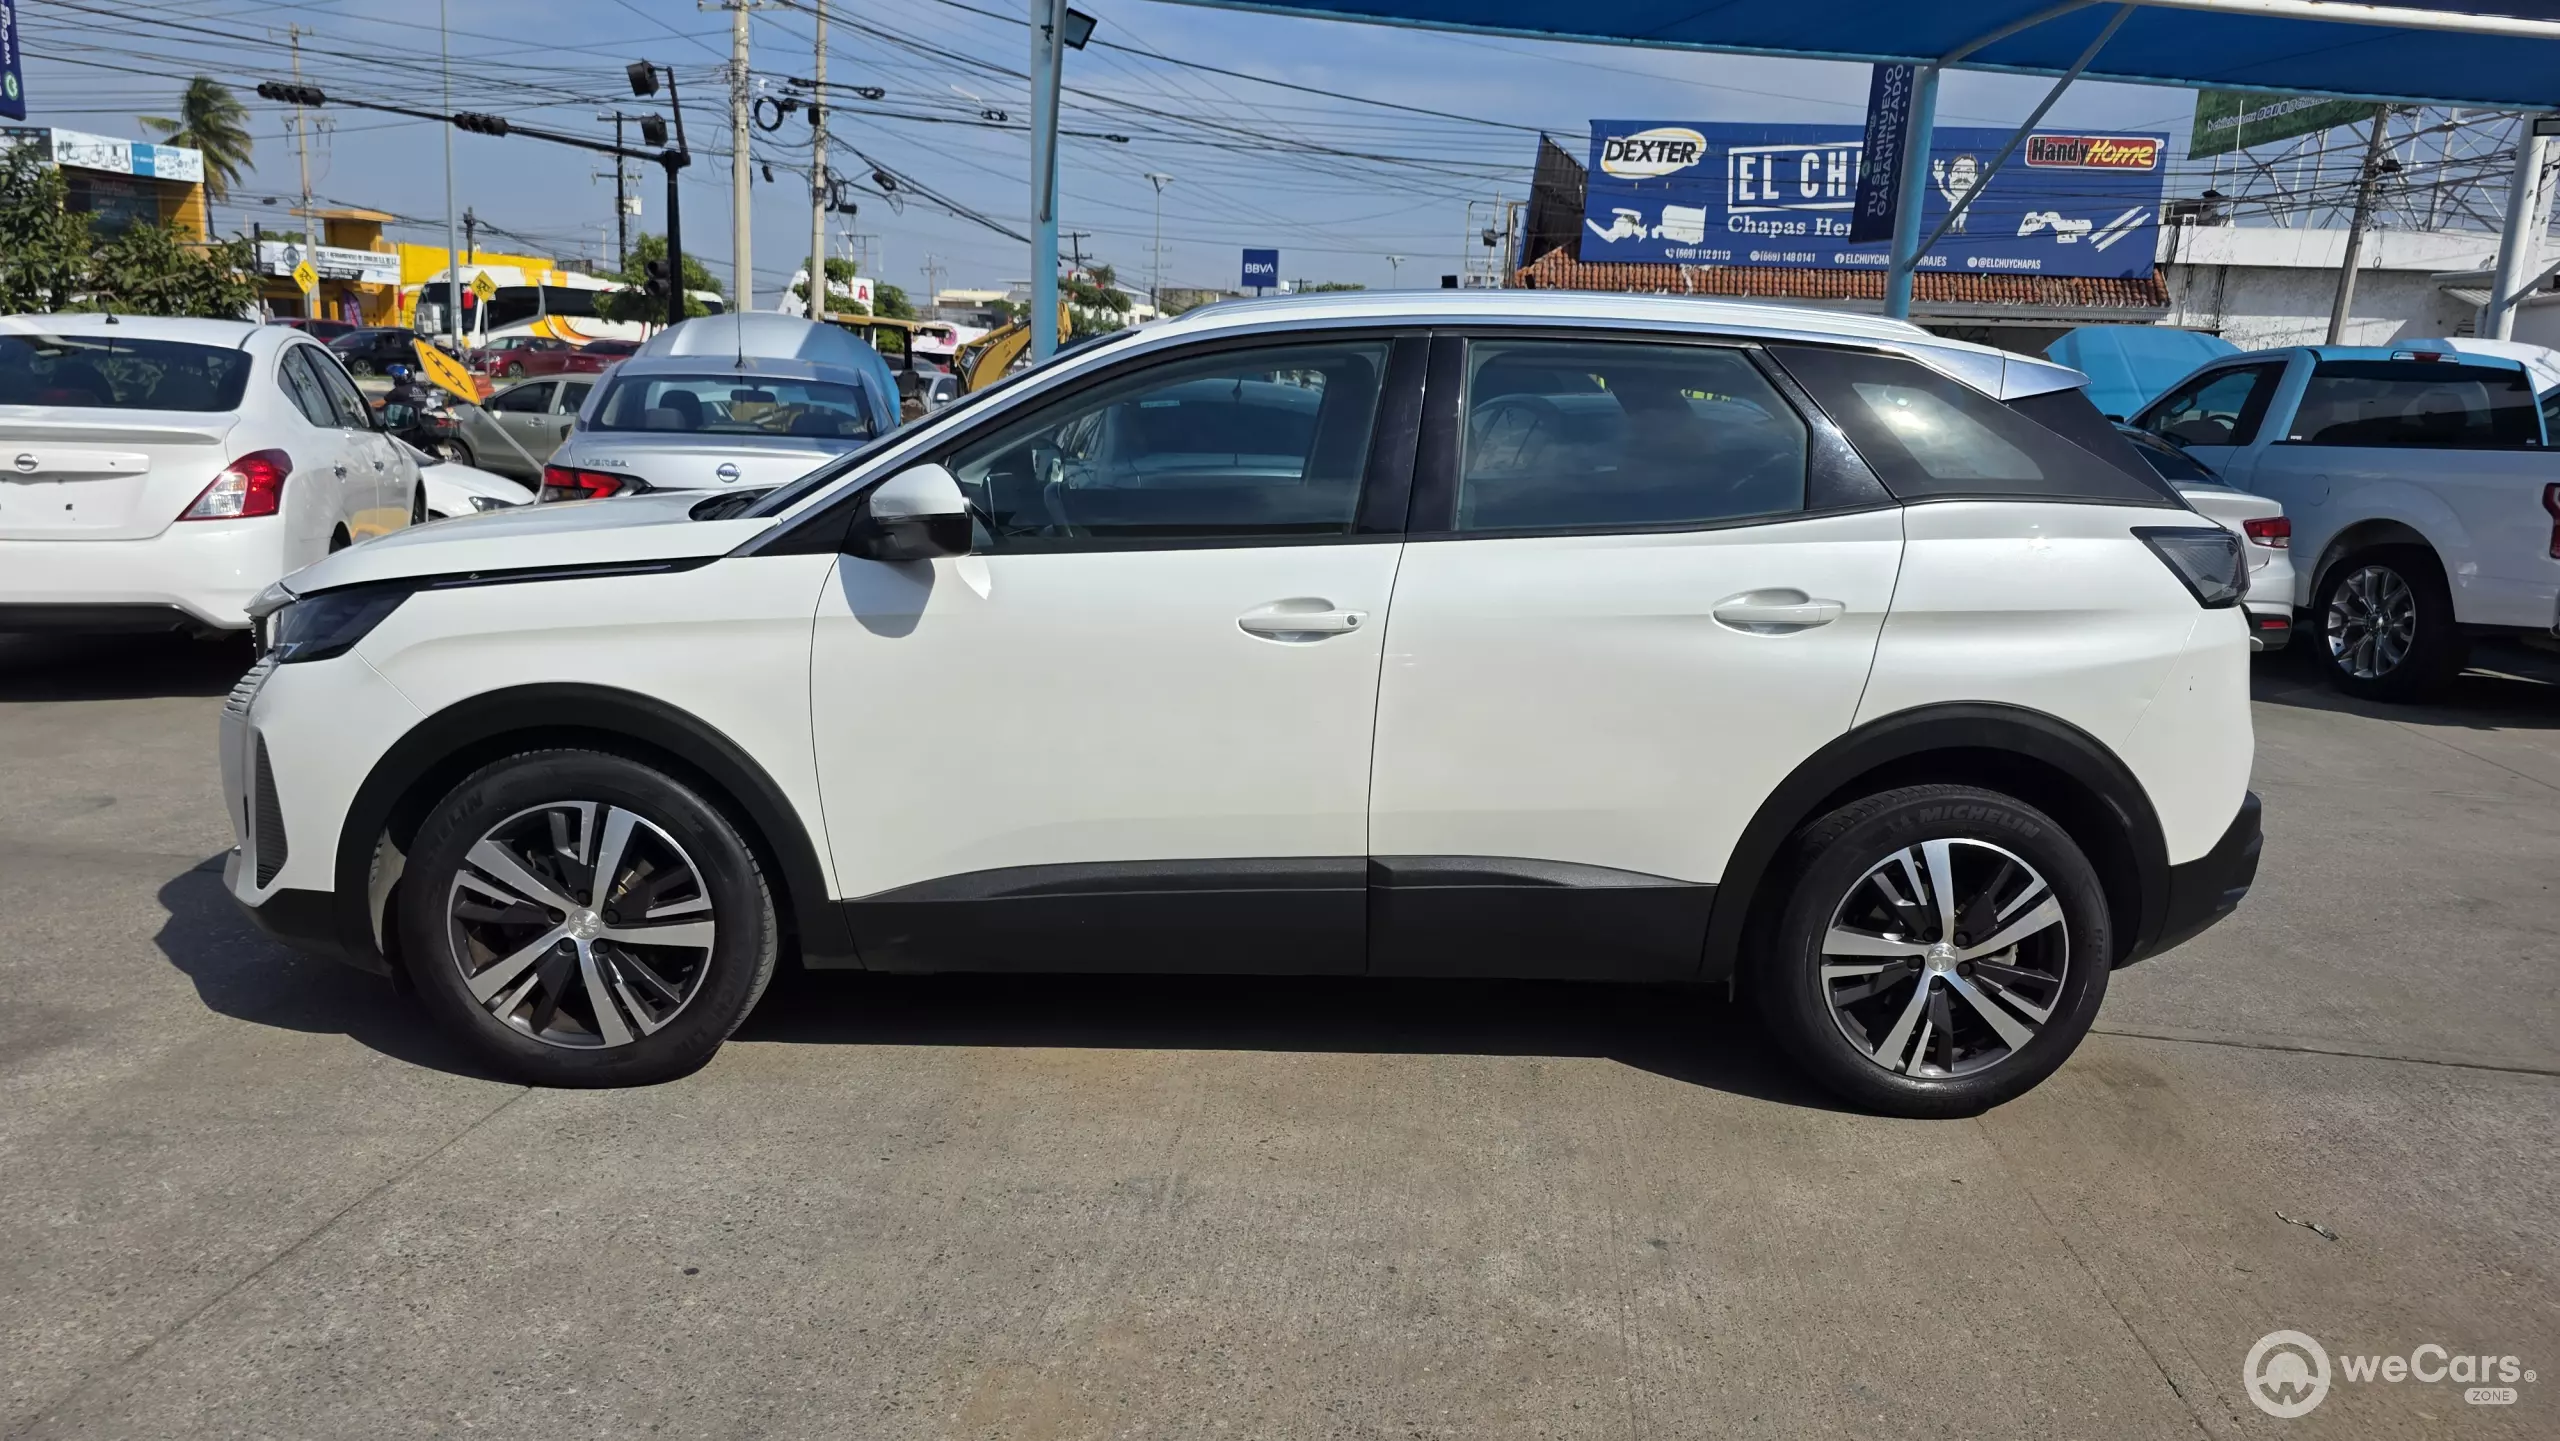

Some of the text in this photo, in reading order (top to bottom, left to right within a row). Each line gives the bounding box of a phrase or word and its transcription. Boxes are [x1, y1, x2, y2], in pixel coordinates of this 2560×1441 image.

[1604, 139, 1697, 163] DEXTER
[1867, 67, 1894, 216] TU SEMINUEVO
[1877, 64, 1904, 217] GARANTIZADO
[1738, 155, 1780, 200] EL
[1728, 215, 1806, 238] Chapas
[1676, 248, 1696, 260] (669)
[1760, 250, 1781, 262] (669)
[1978, 256, 2041, 270] @ELCHUYCHAPAS
[1245, 262, 1274, 273] BBVA
[583, 459, 630, 468] VERSA
[1919, 805, 2041, 838] MICHELIN
